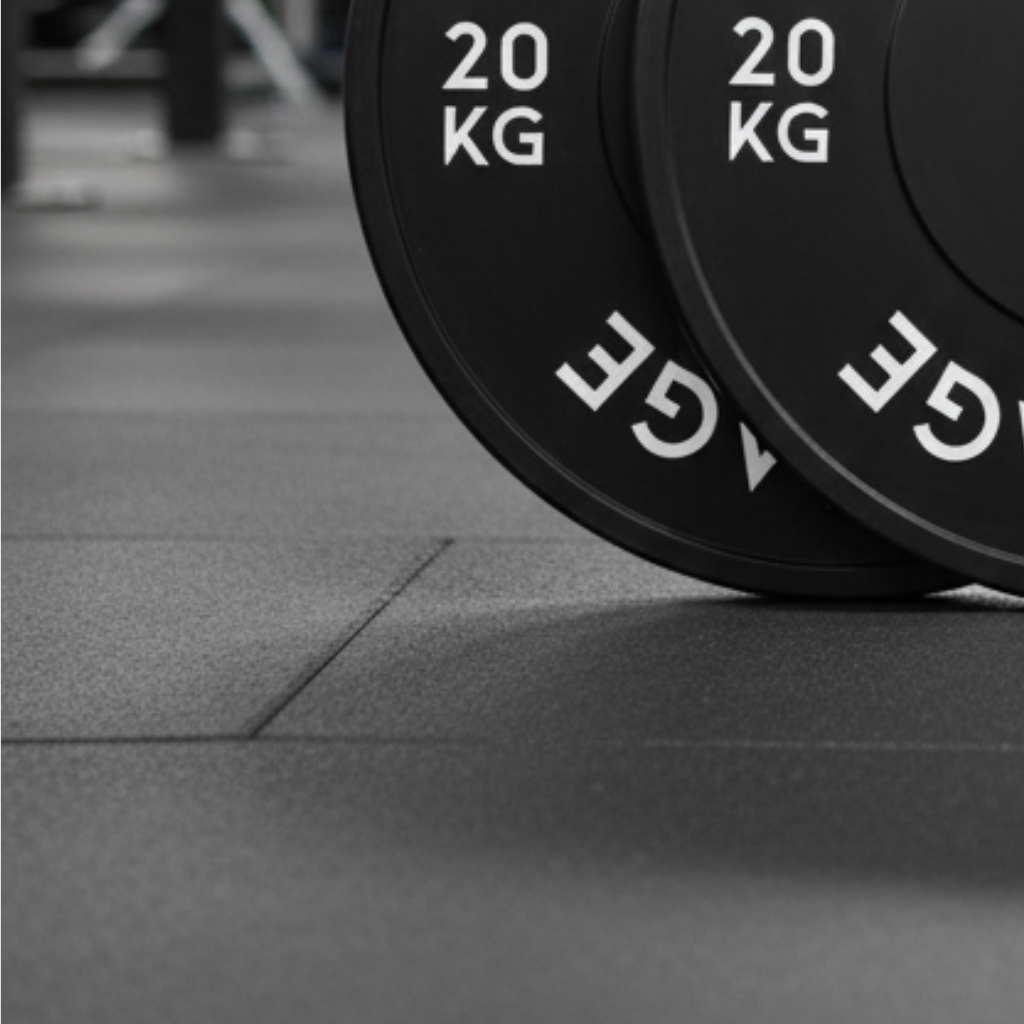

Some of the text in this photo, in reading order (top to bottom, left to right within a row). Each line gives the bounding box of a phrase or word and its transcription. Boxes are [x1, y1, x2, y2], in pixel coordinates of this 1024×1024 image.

[442, 21, 549, 92] 20
[728, 16, 836, 87] 20
[443, 105, 545, 166] KG
[728, 100, 830, 163] KG
